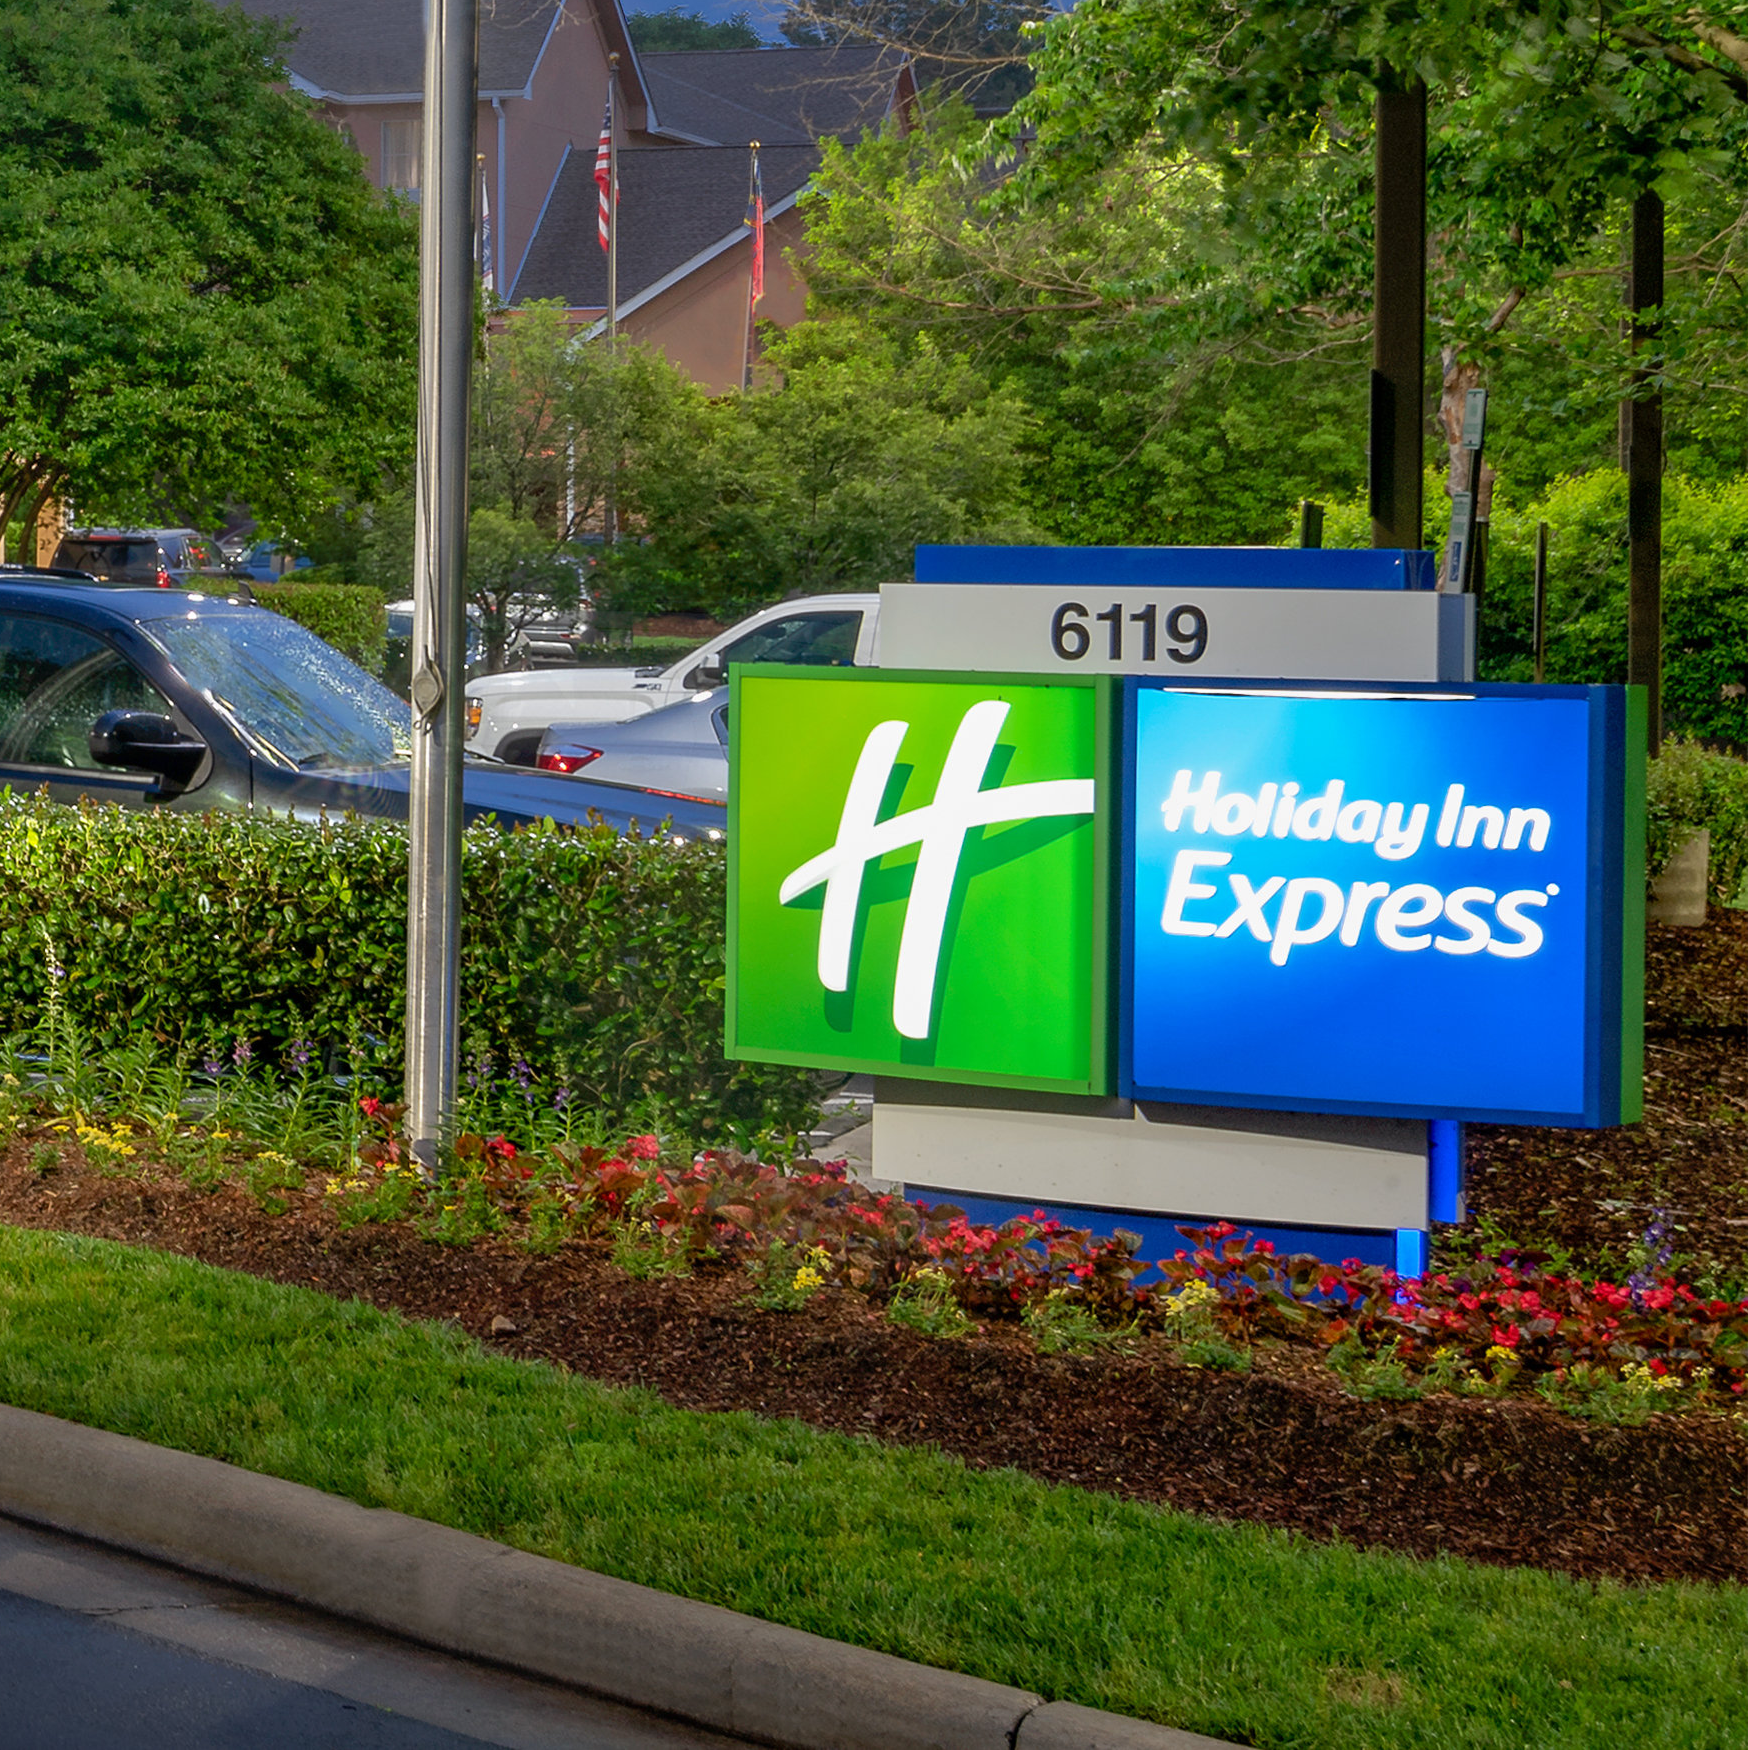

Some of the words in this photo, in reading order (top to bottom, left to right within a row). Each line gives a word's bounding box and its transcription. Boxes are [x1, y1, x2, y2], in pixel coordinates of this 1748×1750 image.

[1051, 602, 1208, 664] 6119
[1161, 769, 1430, 861] Holiday
[1436, 783, 1551, 852] Inn
[779, 700, 1094, 1040] H
[1160, 849, 1550, 967] Express
